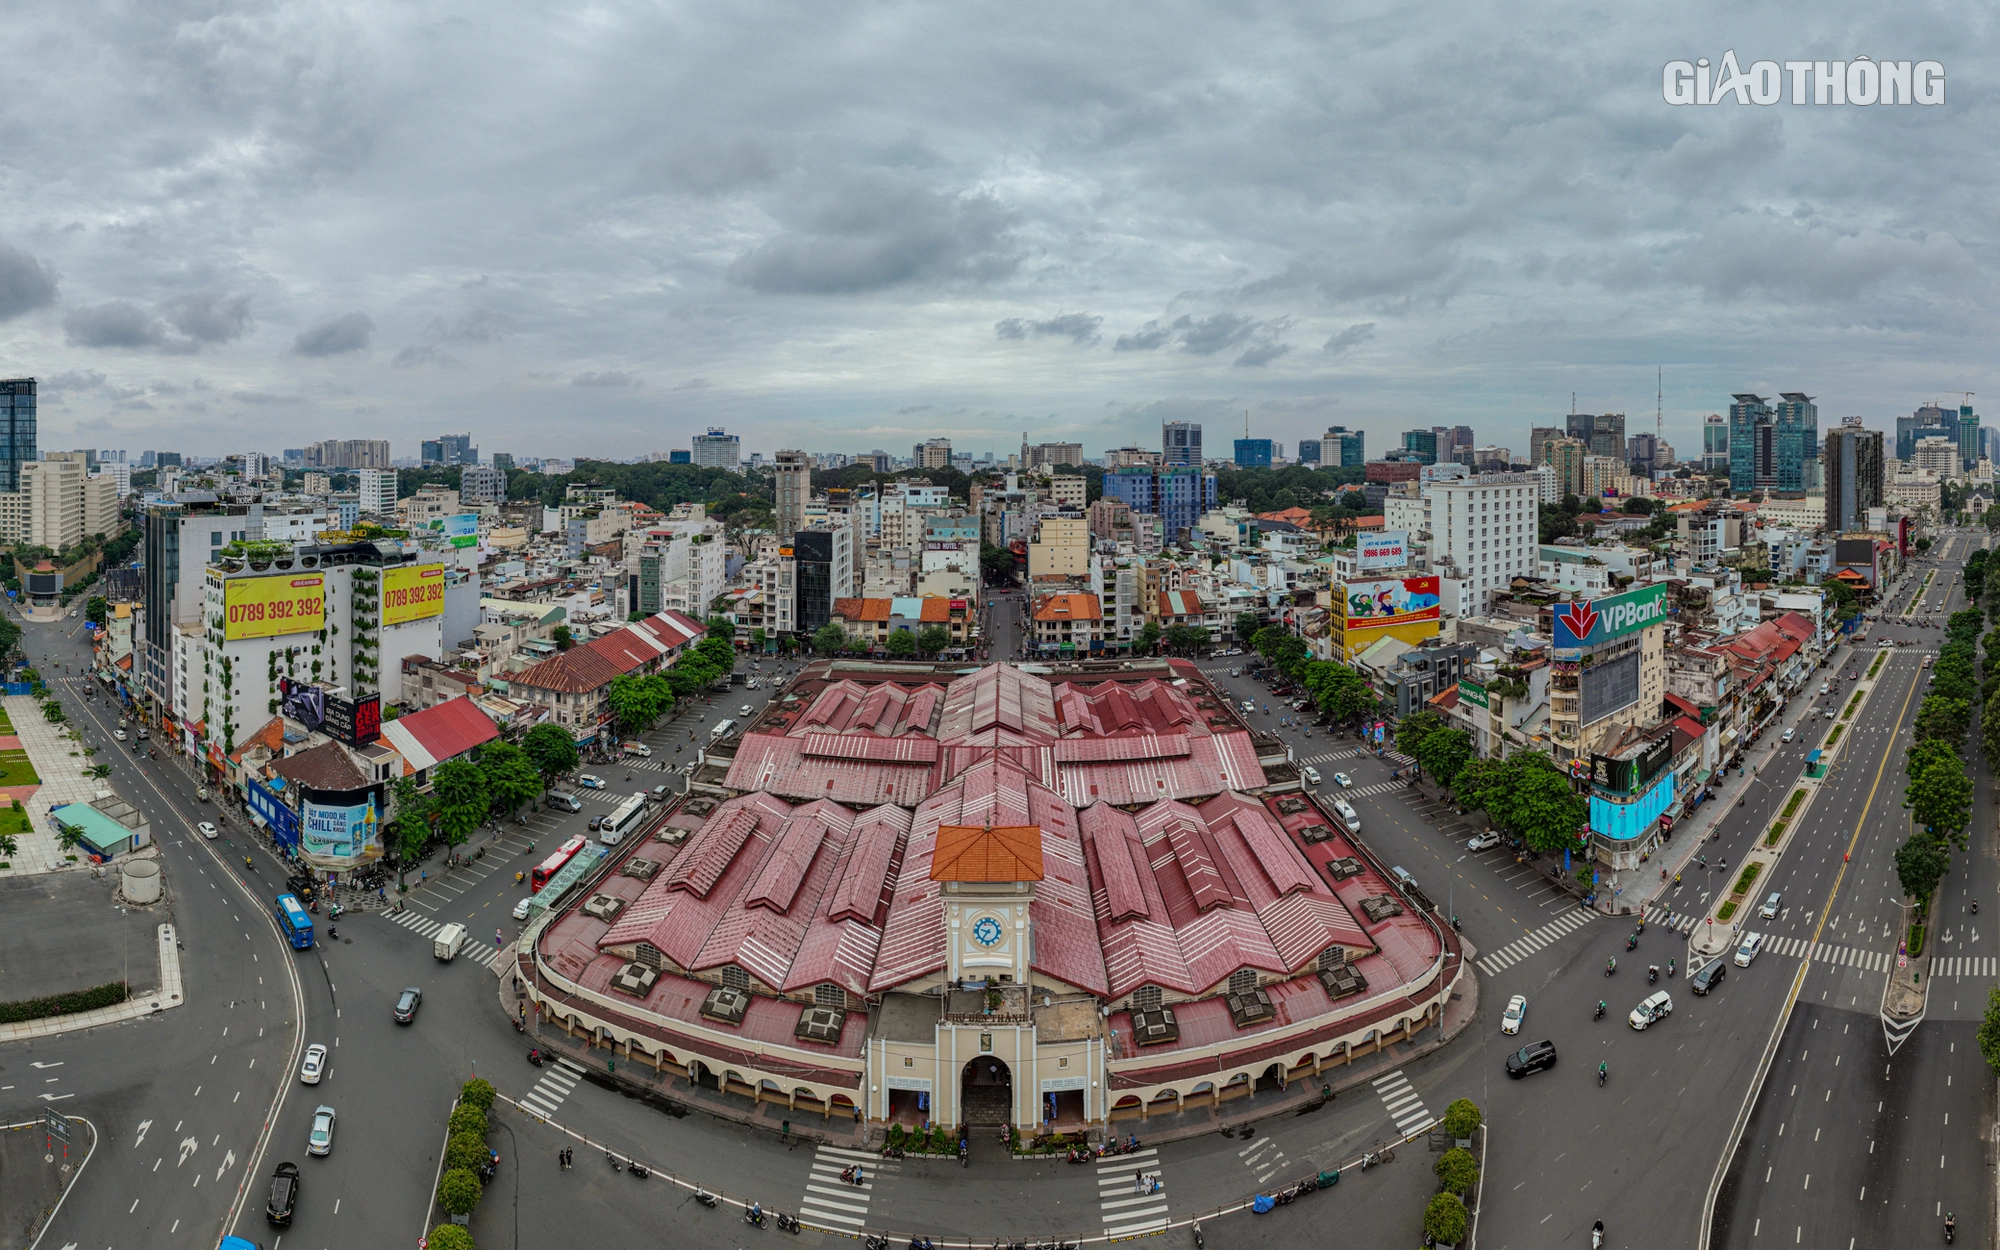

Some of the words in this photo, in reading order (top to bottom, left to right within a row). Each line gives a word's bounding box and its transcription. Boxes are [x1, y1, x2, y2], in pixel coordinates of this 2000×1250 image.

[1503, 473, 1527, 483] CENTRAL
[236, 495, 254, 504] hotel
[318, 529, 368, 539] SILVERLAND
[1364, 548, 1378, 557] 0986
[1391, 547, 1402, 556] 689
[385, 588, 408, 609] 0789
[409, 585, 425, 605] 392
[427, 583, 442, 601] 392
[229, 602, 265, 623] 0789
[268, 599, 293, 620] 392
[296, 597, 321, 616] 392
[1601, 594, 1664, 633] VPBank
[1417, 671, 1436, 682] Amazon
[326, 707, 335, 717] GIA
[358, 700, 379, 714] JUN
[355, 710, 379, 726] GER
[318, 811, 337, 820] MOOD
[308, 817, 332, 832] CHILL
[945, 1012, 966, 1023] CHỢ
[968, 1011, 988, 1022] BẾN
[991, 1011, 1027, 1022] THÀNH
